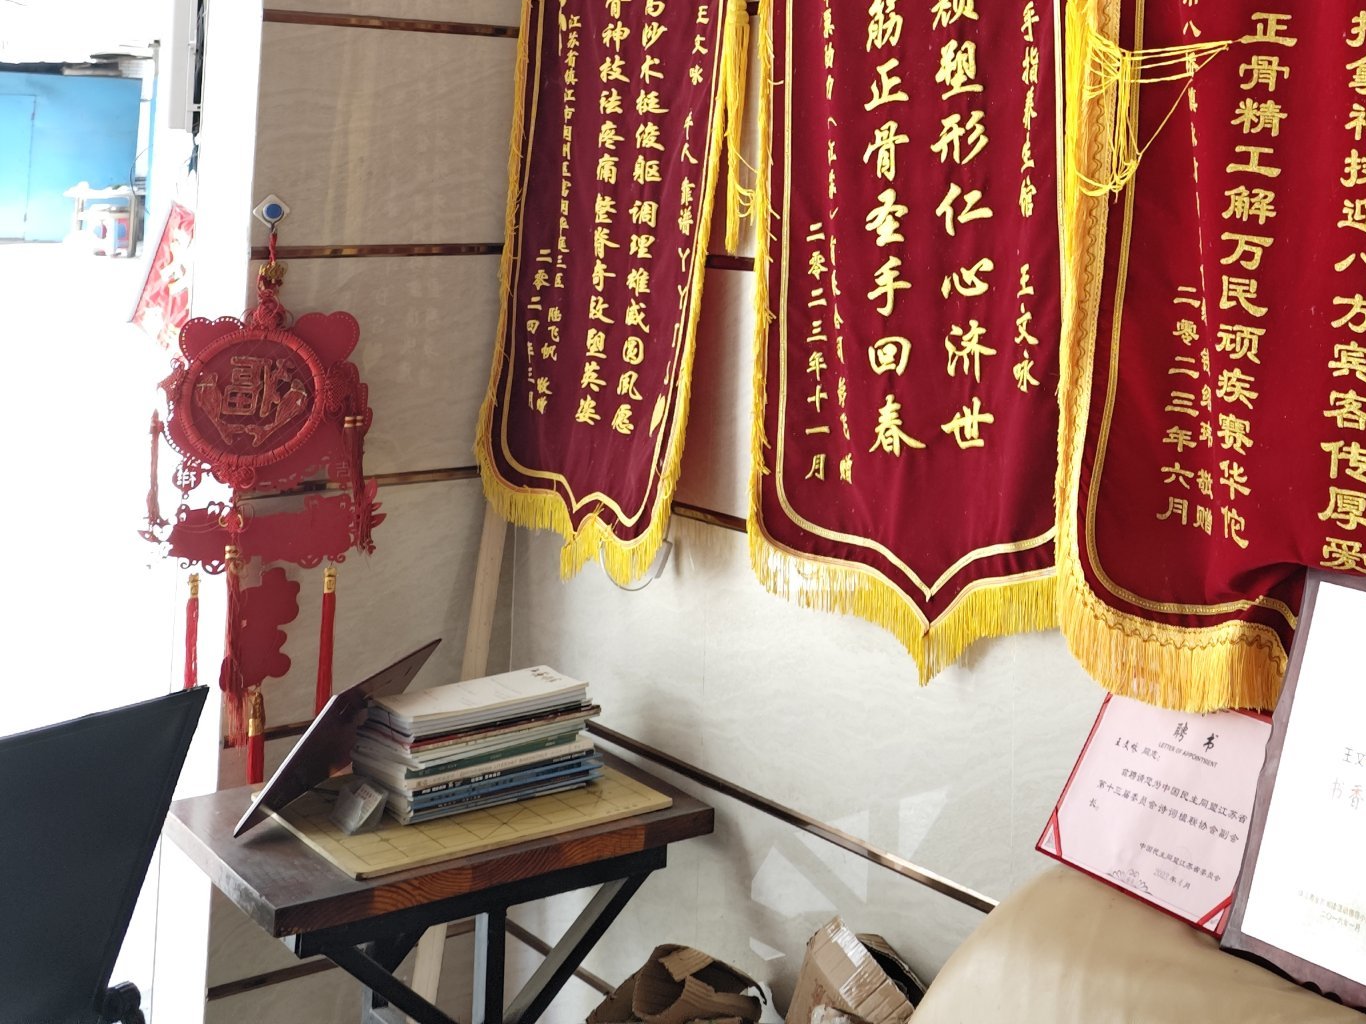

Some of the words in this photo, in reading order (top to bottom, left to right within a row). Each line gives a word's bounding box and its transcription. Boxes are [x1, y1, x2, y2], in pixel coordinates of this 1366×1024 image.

[805, 223, 831, 480] 二零二三年十一月
[1161, 286, 1200, 524] 二零二三年六月
